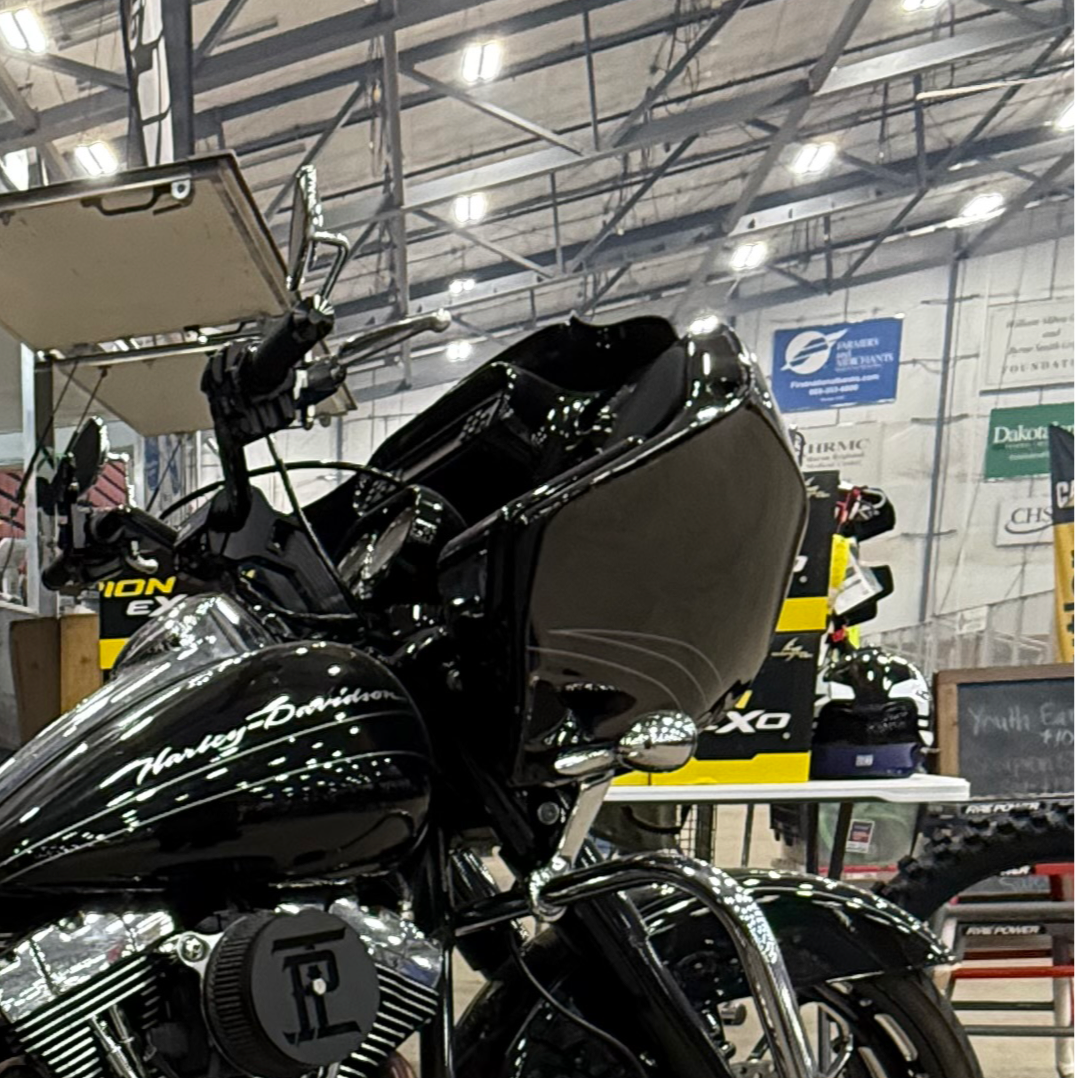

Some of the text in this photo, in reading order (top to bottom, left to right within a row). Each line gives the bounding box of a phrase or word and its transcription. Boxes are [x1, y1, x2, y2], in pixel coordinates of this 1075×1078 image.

[99, 576, 176, 598] ION
[126, 594, 187, 618] EX
[704, 709, 791, 734] XO
[136, 686, 404, 785] Harley-Davidson
